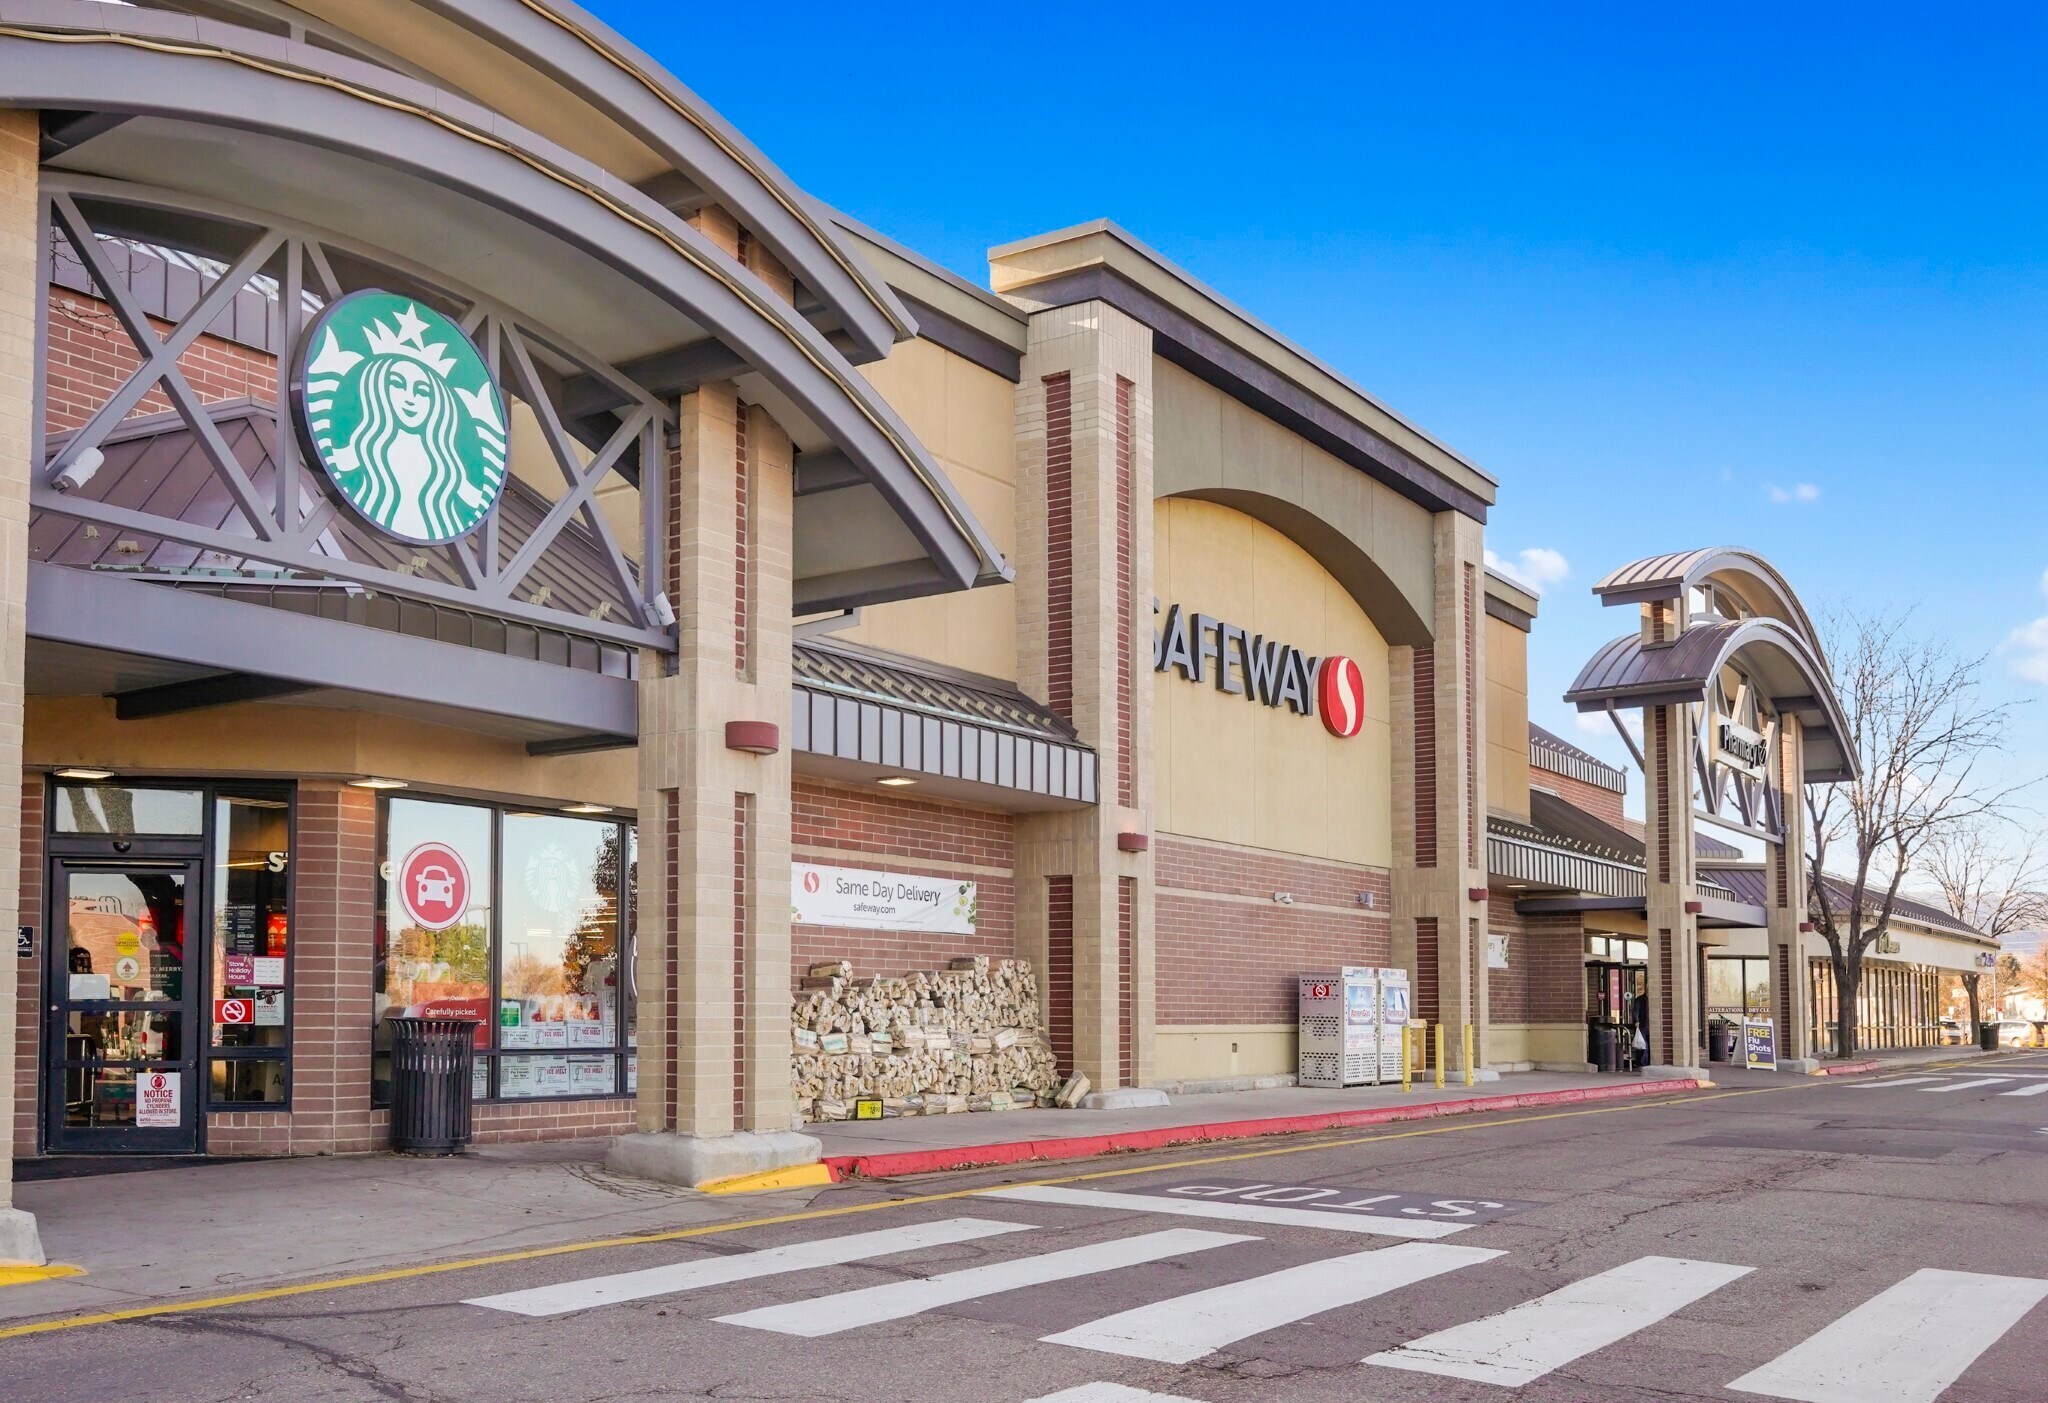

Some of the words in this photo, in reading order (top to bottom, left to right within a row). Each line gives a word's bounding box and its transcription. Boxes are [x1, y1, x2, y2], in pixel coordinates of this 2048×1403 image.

[1718, 724, 1761, 770] Pharmacy
[836, 877, 869, 896] Same
[872, 881, 894, 902] Day
[897, 884, 941, 906] Delivery
[853, 902, 896, 916] safeway.com
[228, 967, 251, 975] Holiday
[425, 1007, 454, 1018] Carefully
[455, 1008, 478, 1018] picked.
[1747, 1027, 1771, 1038] FREE
[1747, 1036, 1760, 1044] Flu
[1748, 1044, 1771, 1053] Shots
[144, 1089, 173, 1098] NOTICE
[1167, 1184, 1505, 1217] STOP
